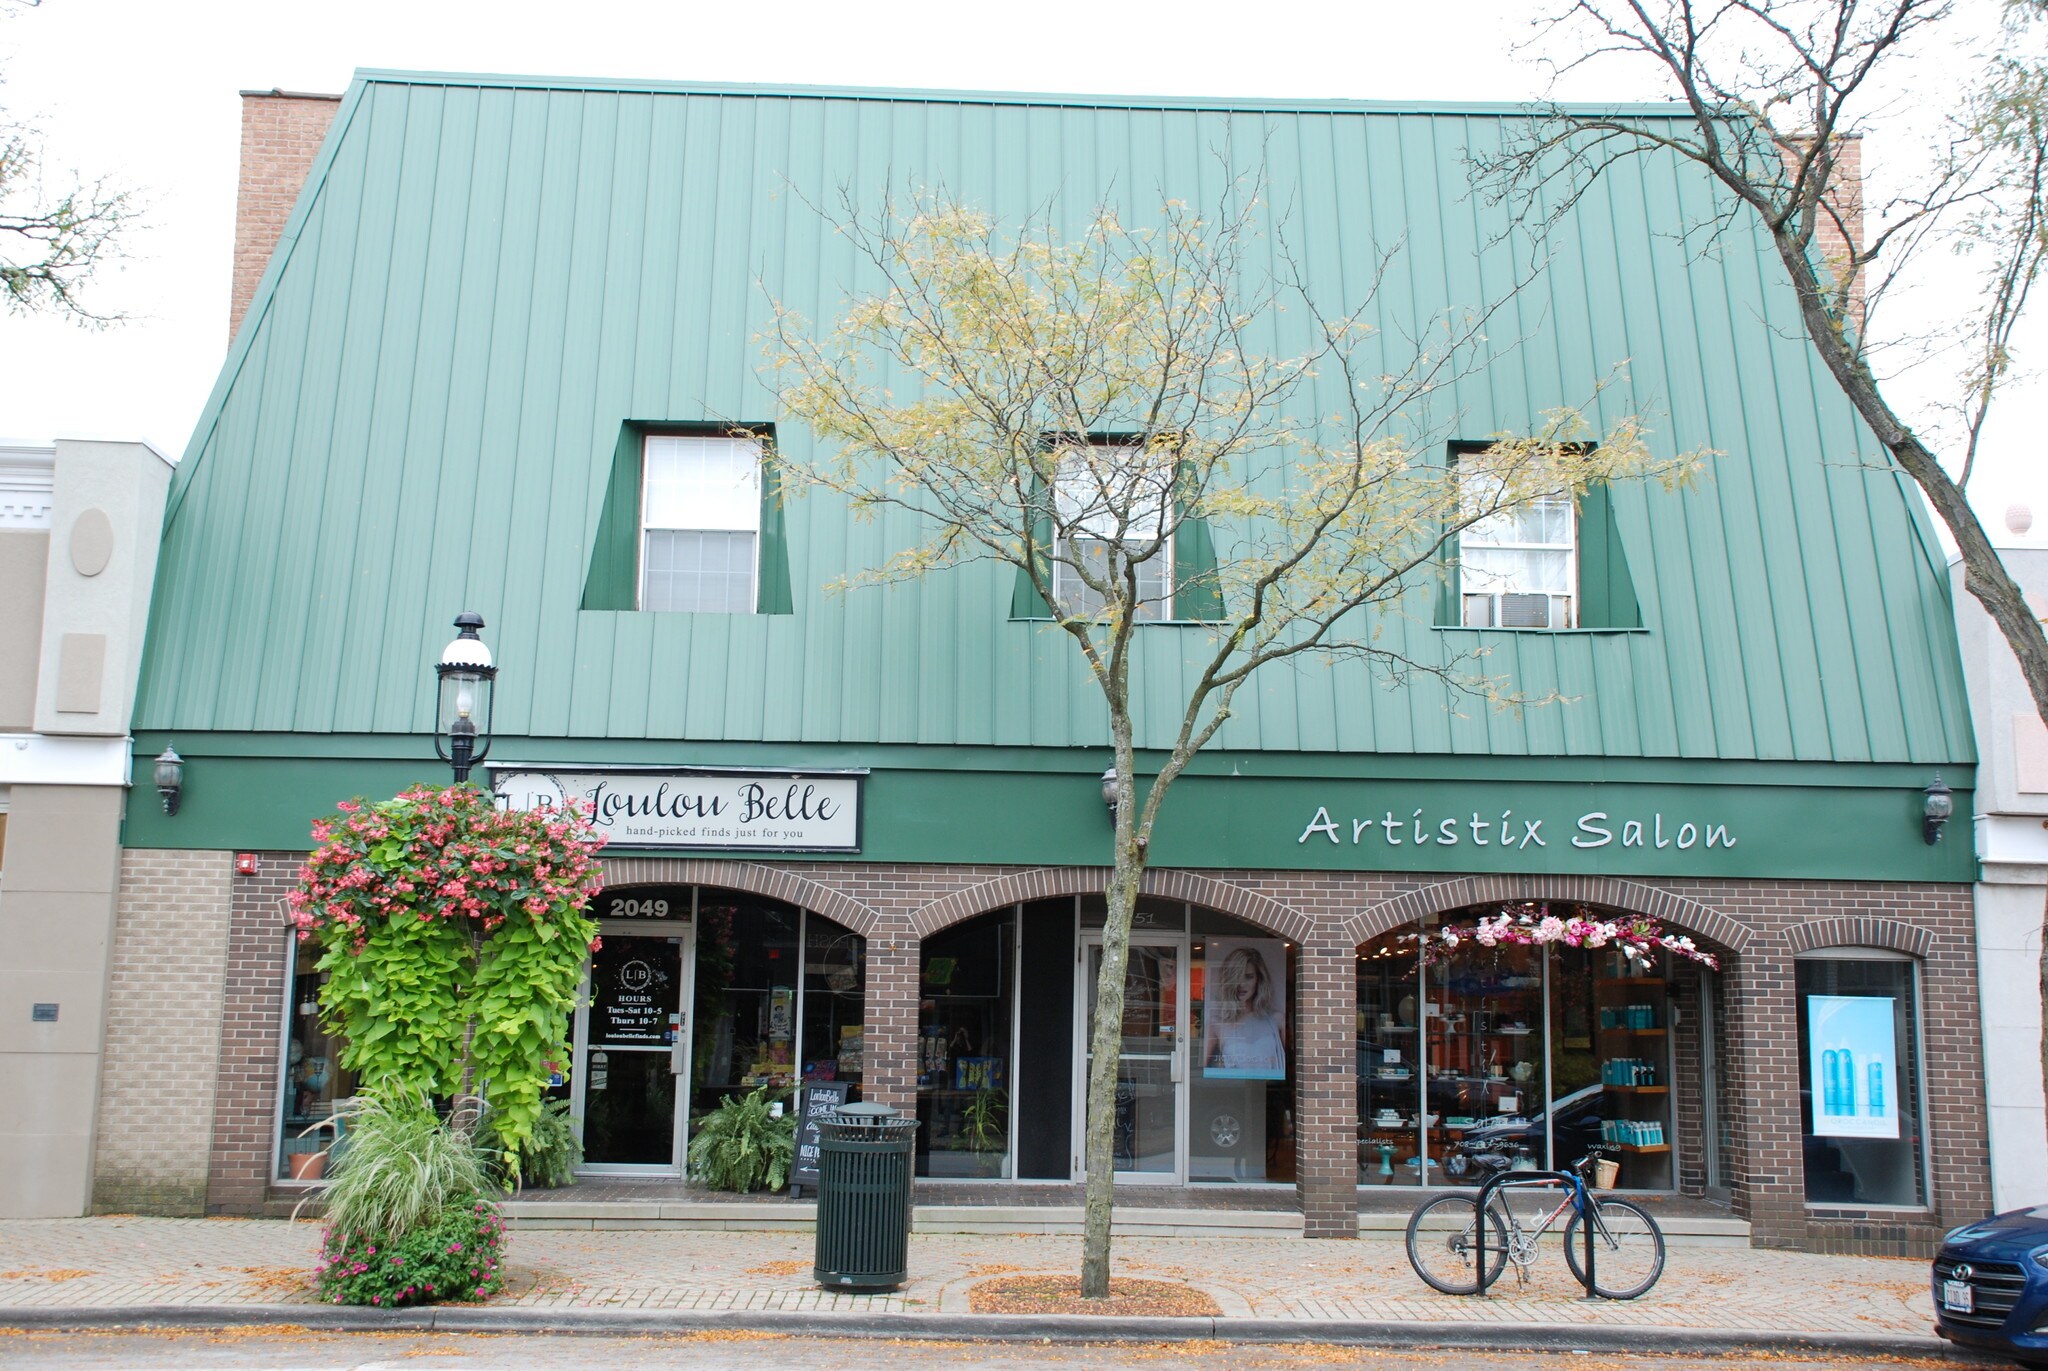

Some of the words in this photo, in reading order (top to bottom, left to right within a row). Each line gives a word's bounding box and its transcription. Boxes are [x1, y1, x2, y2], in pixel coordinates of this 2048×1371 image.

[585, 780, 729, 828] Loulou
[738, 781, 841, 823] Belle
[625, 825, 696, 838] hand-picked
[701, 826, 731, 838] finds
[734, 827, 757, 840] just
[762, 828, 778, 838] for
[783, 830, 803, 840] you
[1299, 806, 1546, 849] Artistix
[1571, 811, 1736, 849] Salon
[610, 898, 668, 917] 2049
[1133, 912, 1156, 924] 51
[618, 995, 652, 1003] HOURS
[607, 1006, 641, 1014] Tues-Sat
[643, 1007, 662, 1015] 10-5
[639, 1017, 658, 1025] 10-7
[810, 1105, 828, 1115] COME
[1356, 1138, 1394, 1146] pecialists
